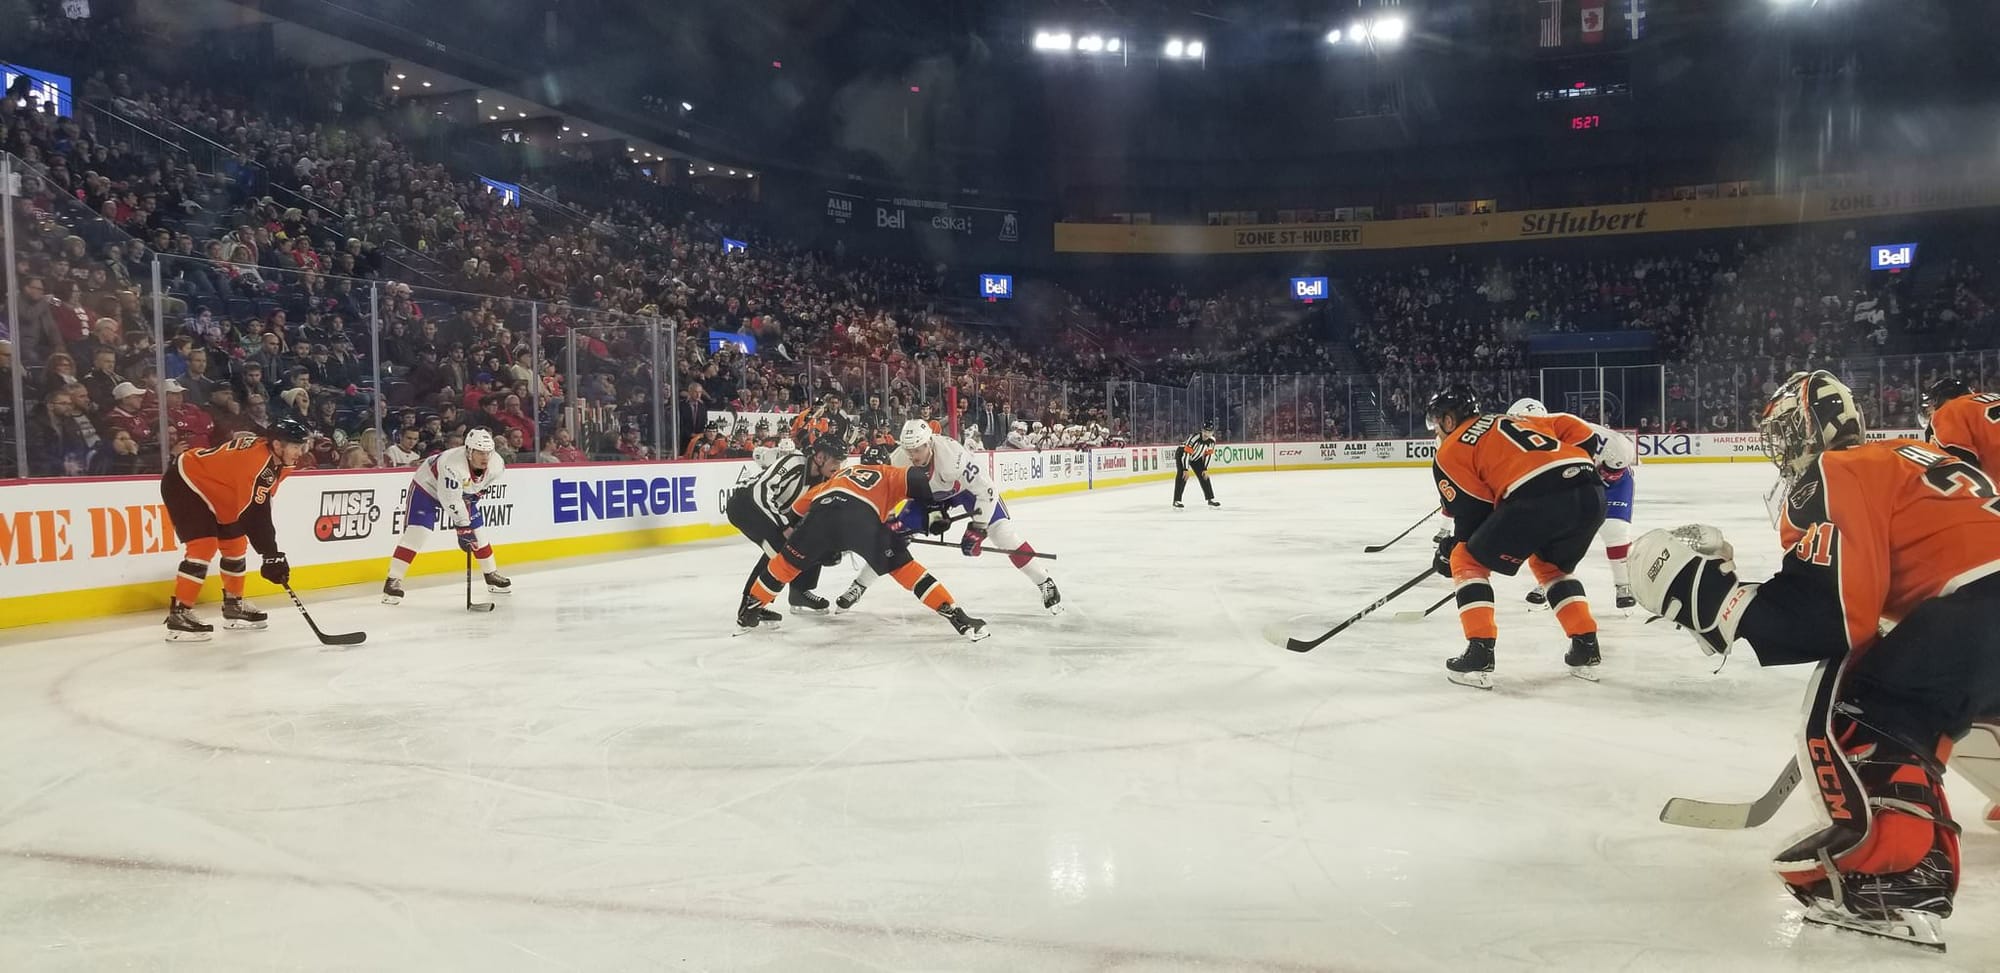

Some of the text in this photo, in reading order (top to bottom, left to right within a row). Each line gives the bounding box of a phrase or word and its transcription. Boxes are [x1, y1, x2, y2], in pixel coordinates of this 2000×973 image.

[876, 208, 905, 229] Bell
[932, 214, 966, 231] eska
[1237, 229, 1360, 245] ZONE ST-HUBERT
[1878, 247, 1911, 266] Bell
[985, 278, 1007, 294] Bell
[1297, 280, 1321, 296] Bell
[1497, 417, 1561, 452] 6
[1638, 434, 1692, 456] ska
[1214, 446, 1264, 464] SPORTIUM
[1320, 449, 1336, 457] KIA
[962, 461, 980, 484] 25
[1031, 456, 1044, 479] Bell
[255, 485, 269, 504] 5
[1438, 479, 1457, 502] 6
[322, 492, 373, 516] MISE
[1722, 588, 1746, 621] CCM
[1808, 736, 1852, 819] CCM
